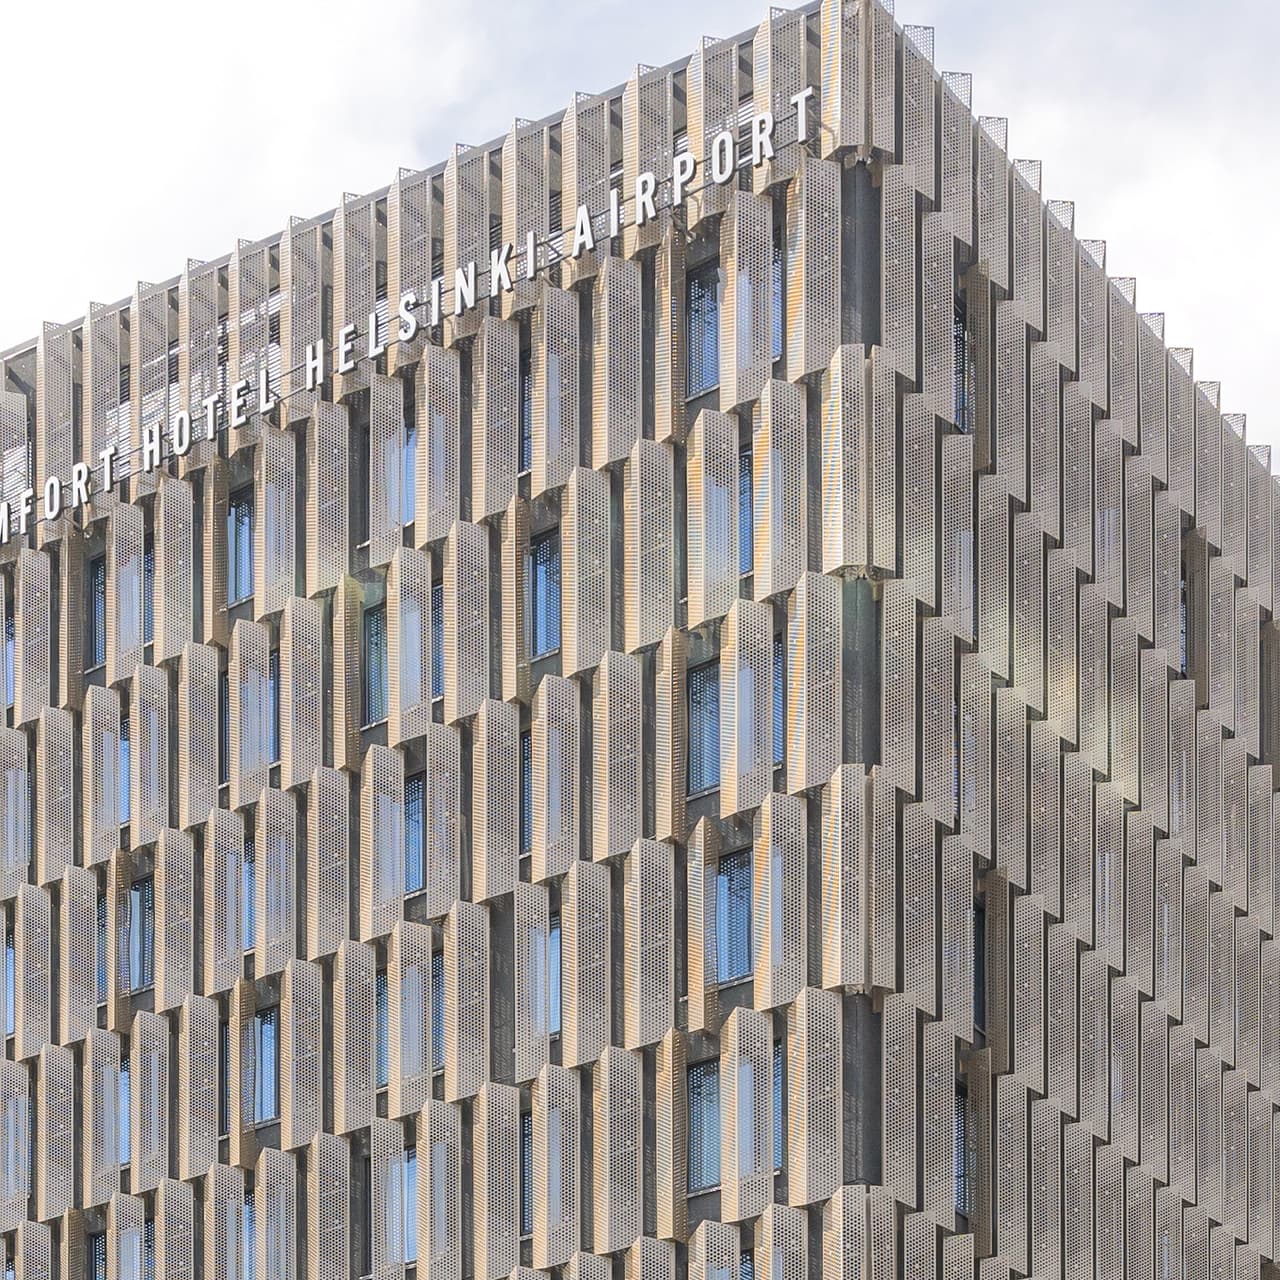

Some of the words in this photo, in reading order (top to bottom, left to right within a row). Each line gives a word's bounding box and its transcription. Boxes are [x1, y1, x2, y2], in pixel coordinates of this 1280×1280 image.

[142, 367, 276, 475] HOTEL
[305, 229, 538, 391] HELSINKI
[571, 86, 818, 258] AIRPORT
